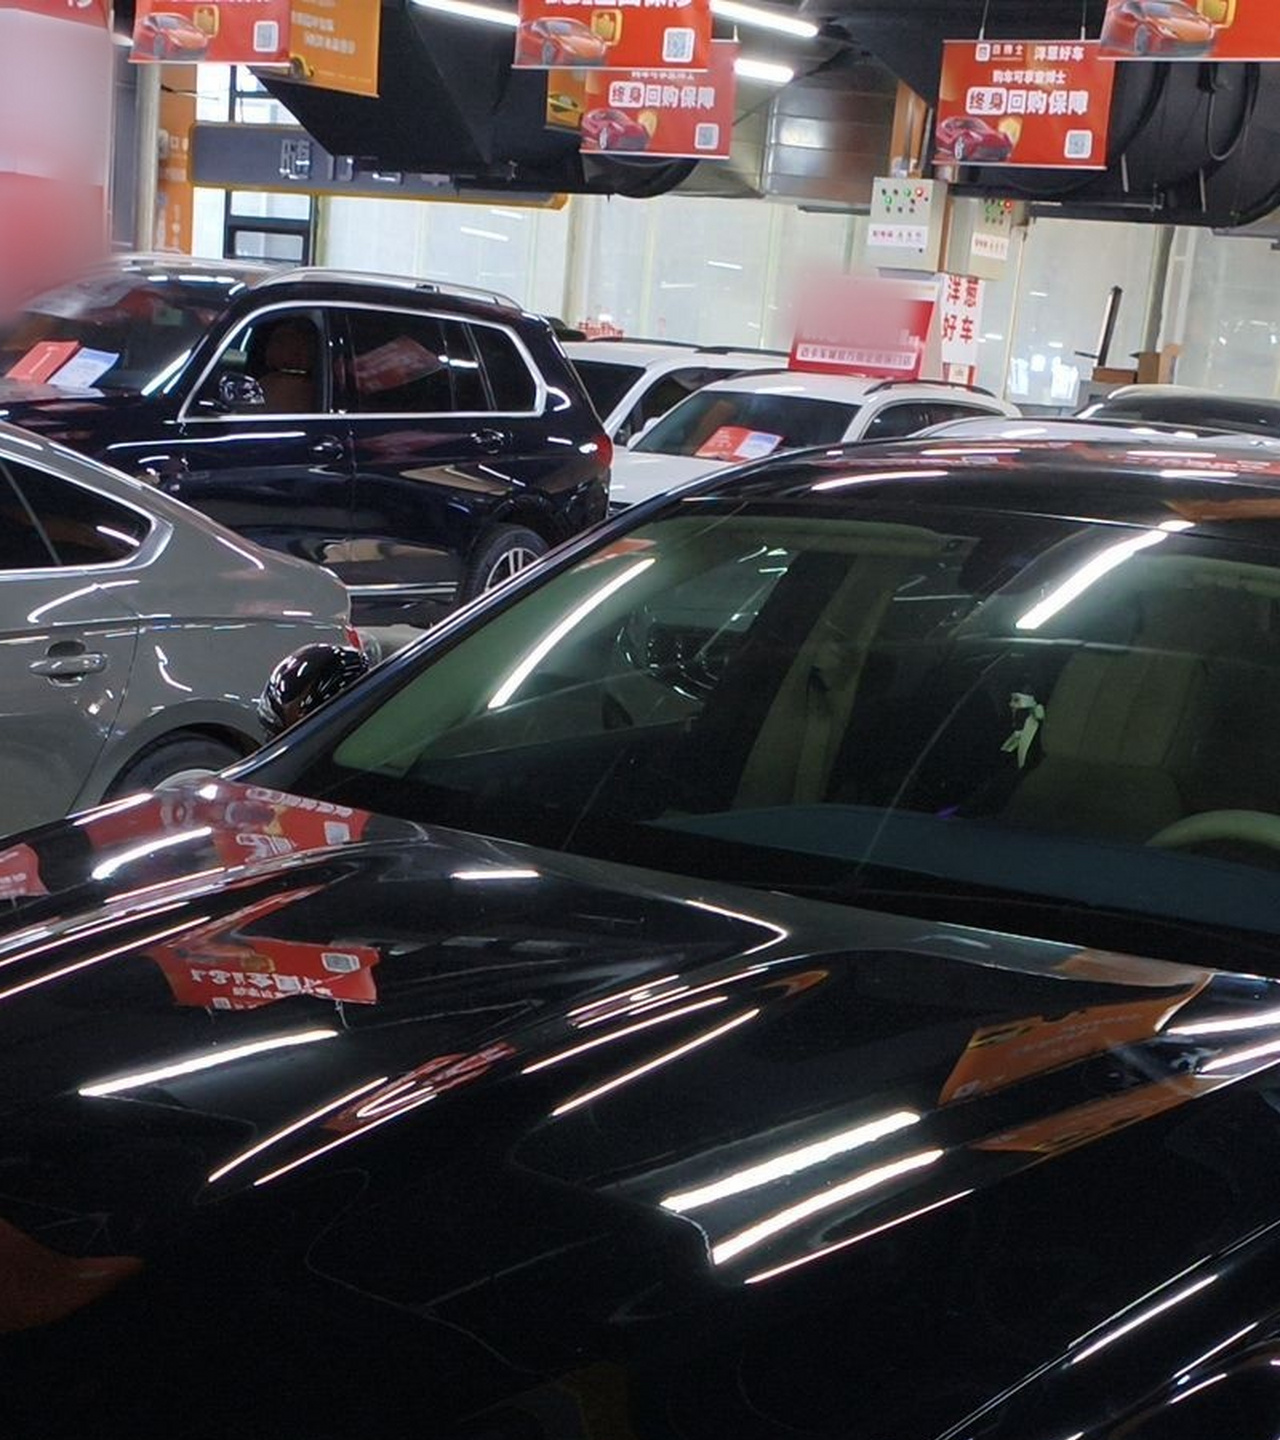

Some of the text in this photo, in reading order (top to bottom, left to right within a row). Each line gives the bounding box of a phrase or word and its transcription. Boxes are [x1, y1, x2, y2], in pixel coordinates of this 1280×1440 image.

[611, 83, 716, 109] 终身回购保障
[968, 89, 1089, 115] 终身回购保障
